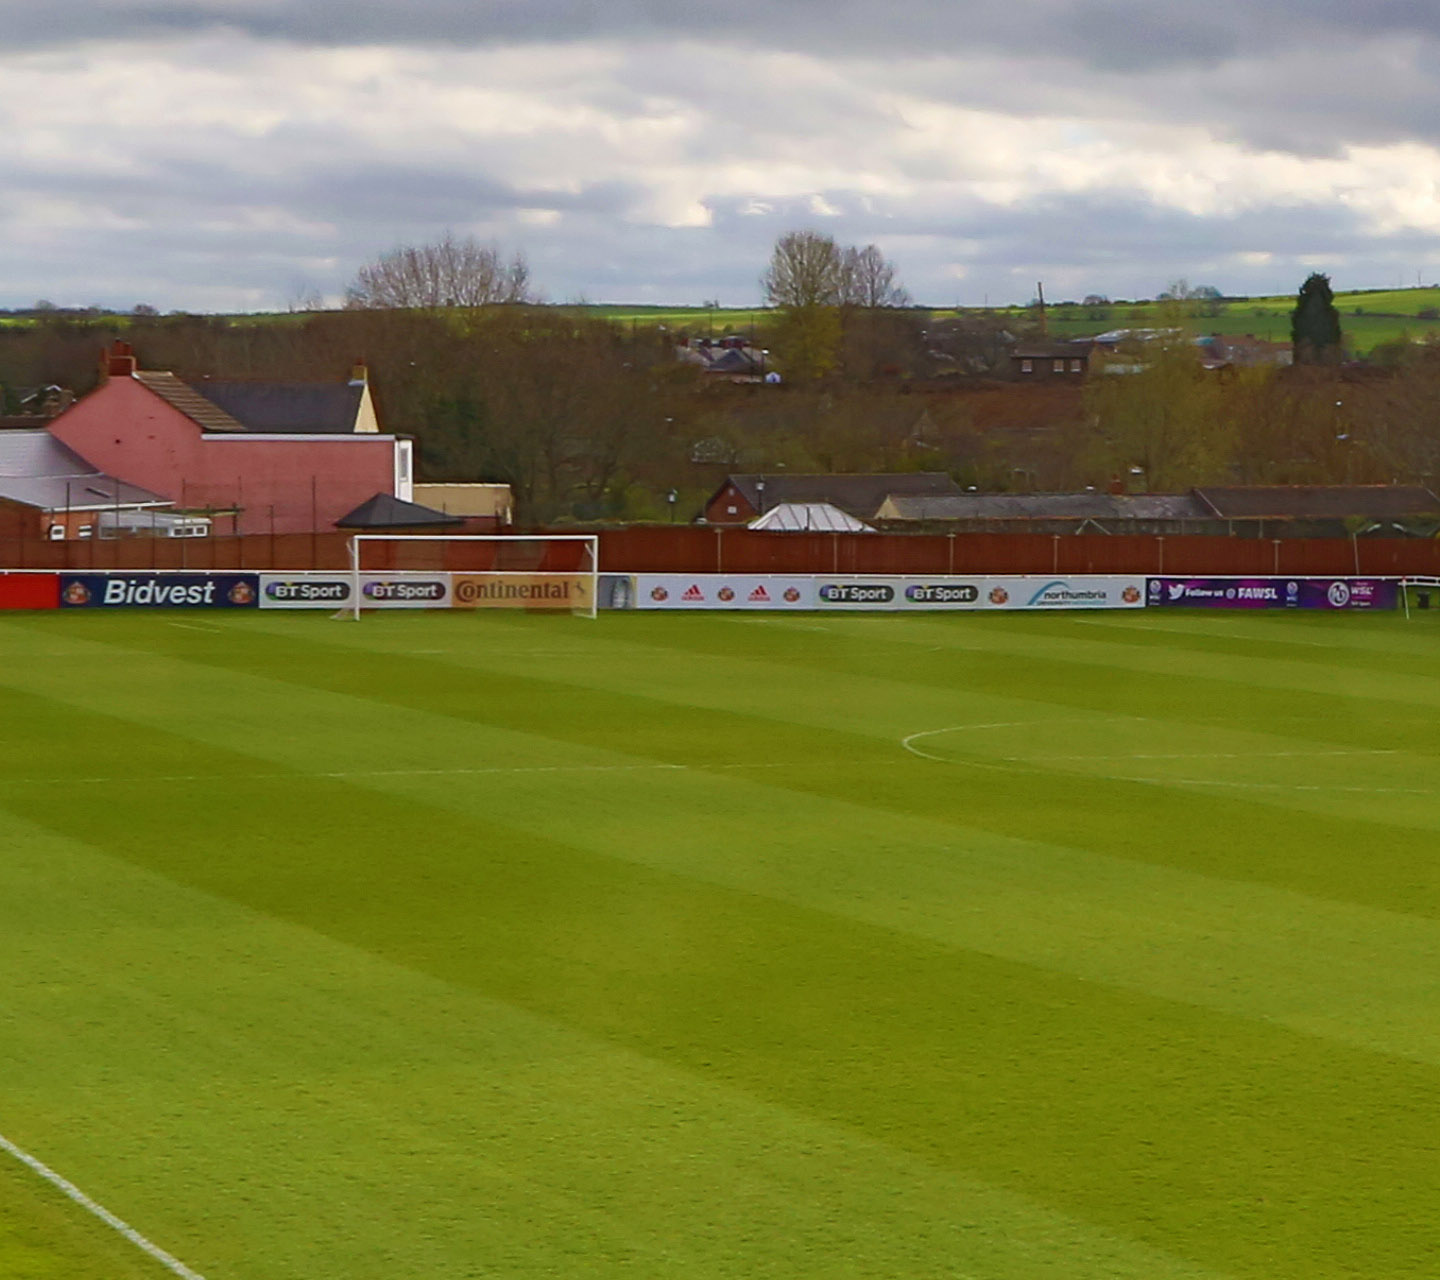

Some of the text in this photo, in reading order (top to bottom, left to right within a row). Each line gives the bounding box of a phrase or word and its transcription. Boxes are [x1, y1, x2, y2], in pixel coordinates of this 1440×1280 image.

[103, 580, 216, 604] Bidvest
[275, 585, 342, 600] BT Sport
[372, 585, 437, 600] BT Sport
[455, 580, 568, 602] Continental
[828, 588, 887, 601] BT Sport
[913, 588, 971, 601] BT Sport
[1044, 590, 1106, 600] northumbria
[1238, 587, 1278, 599] FAWSL
